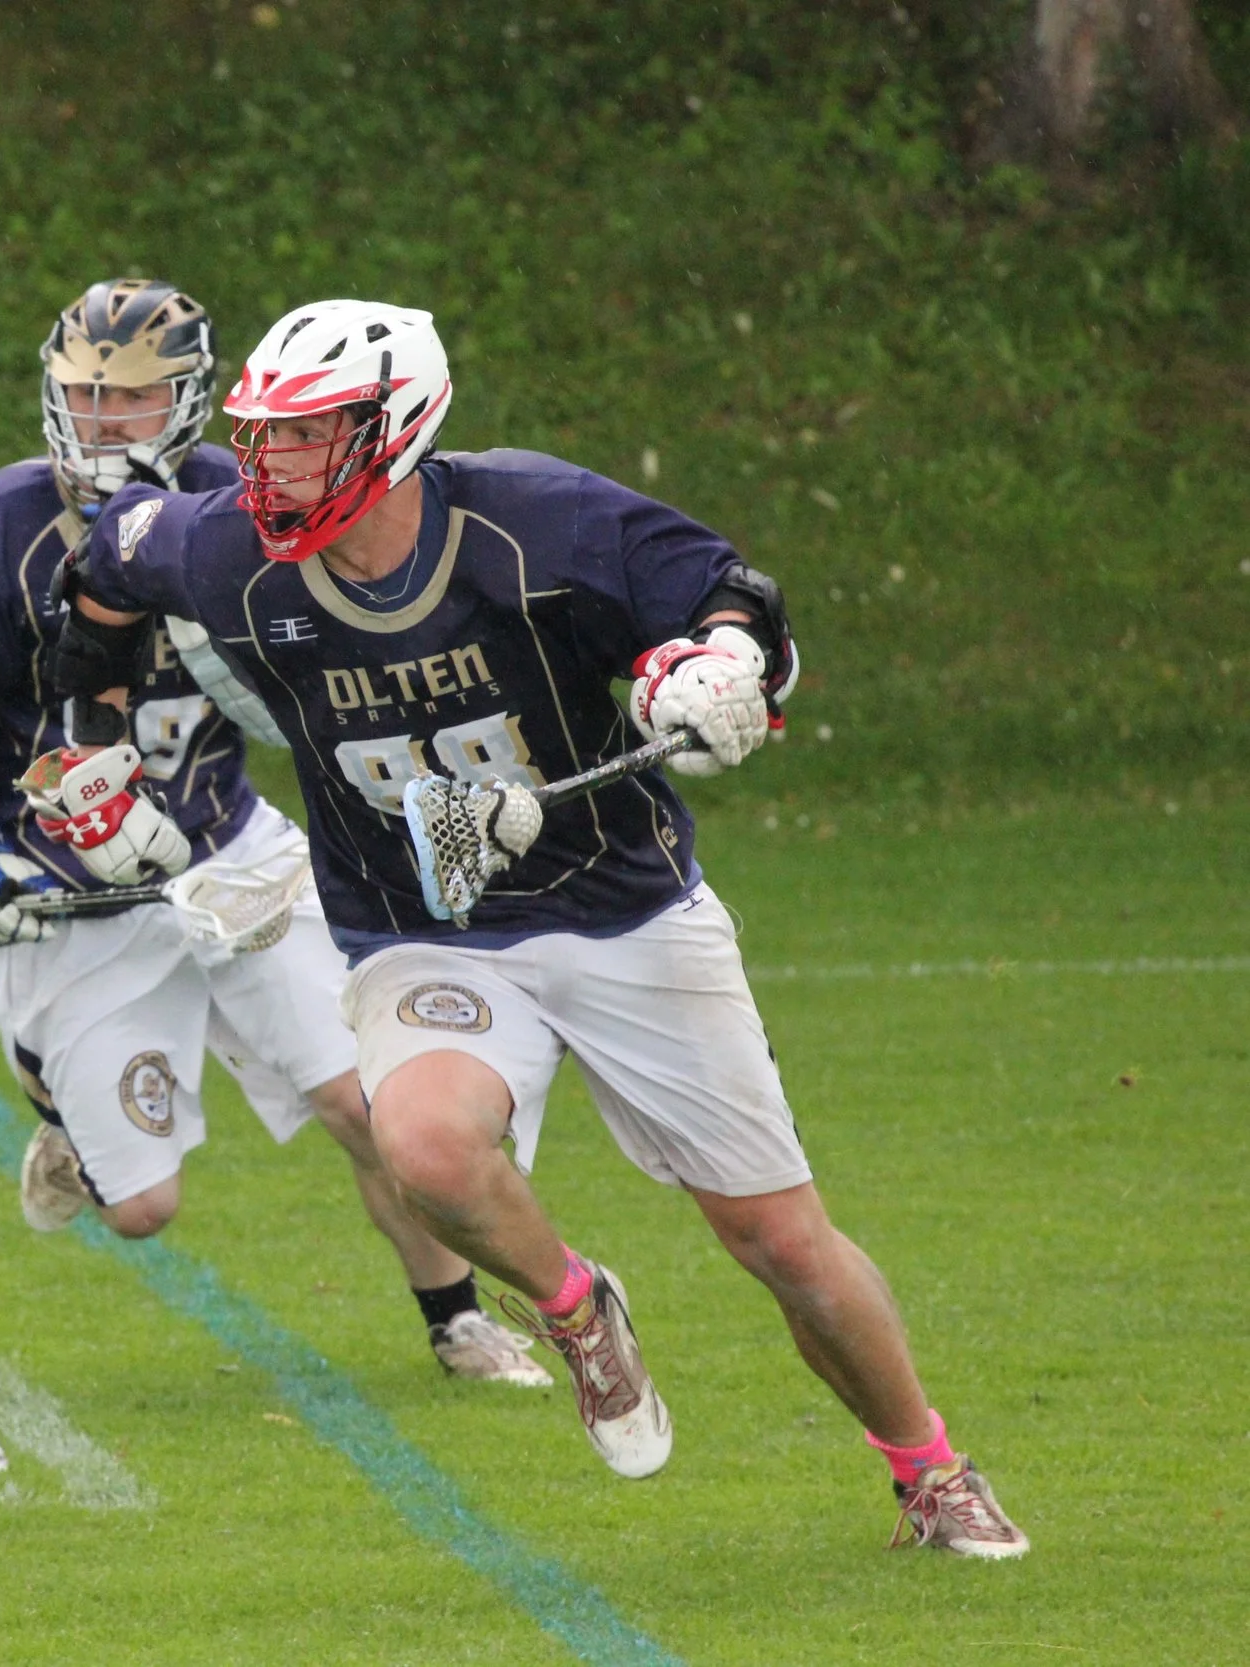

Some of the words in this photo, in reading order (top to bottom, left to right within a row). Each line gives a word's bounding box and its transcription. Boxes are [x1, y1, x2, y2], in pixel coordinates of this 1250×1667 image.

[322, 643, 494, 710] OLTEN
[336, 682, 501, 725] SAINTS
[80, 777, 110, 801] 88
